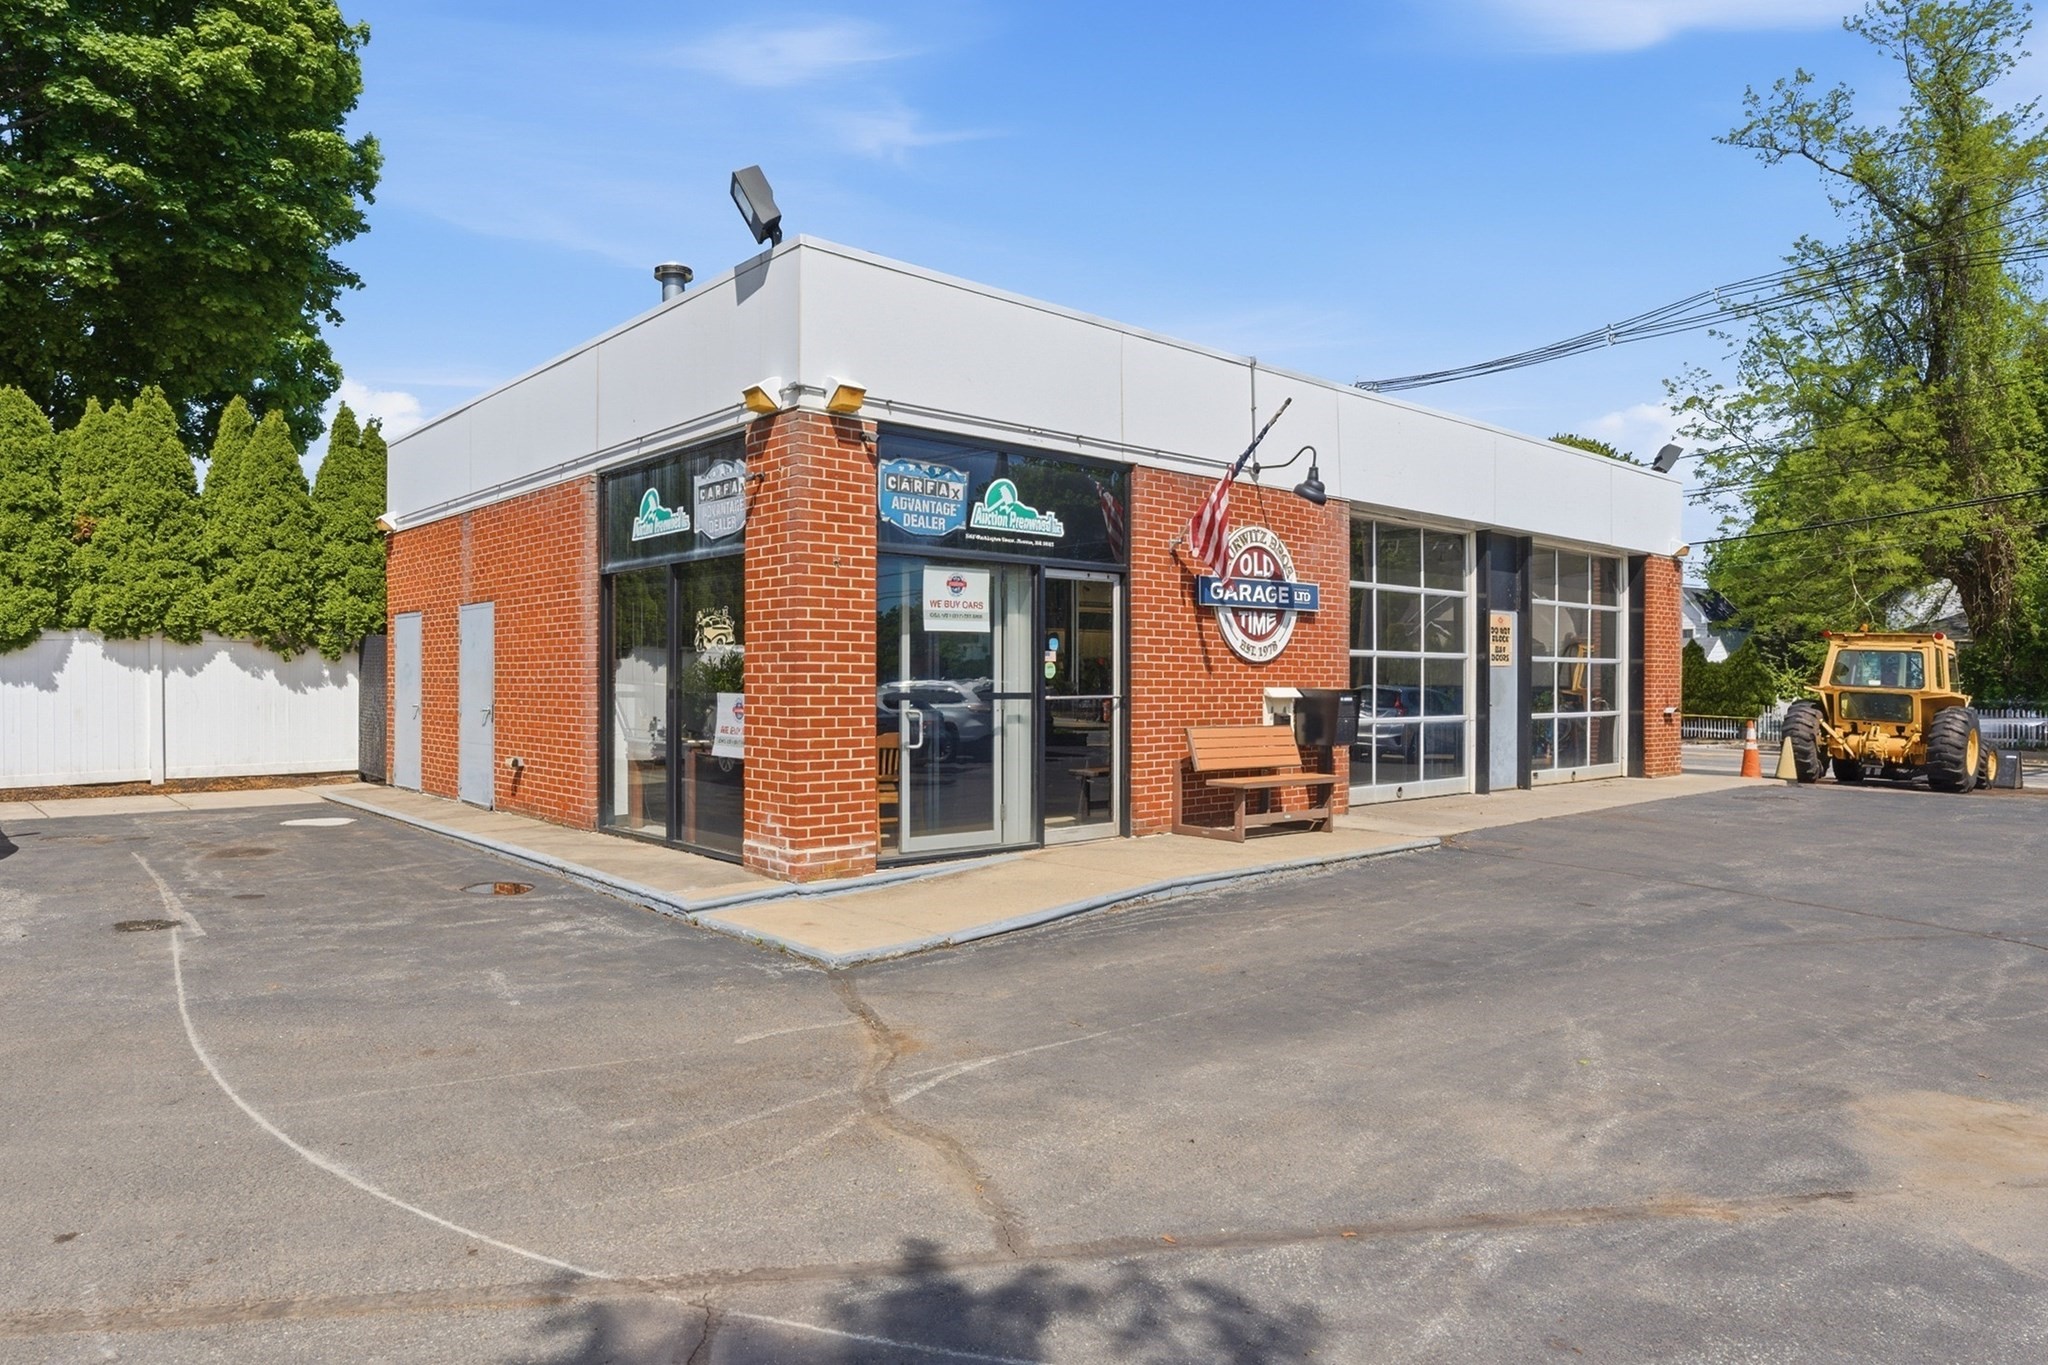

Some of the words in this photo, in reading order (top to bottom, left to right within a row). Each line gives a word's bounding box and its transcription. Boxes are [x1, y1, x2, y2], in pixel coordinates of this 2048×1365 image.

[887, 476, 960, 500] CARFAX
[892, 496, 957, 517] ADVANTAGE
[903, 513, 946, 531] DEALER
[1228, 529, 1267, 562] URWITZ
[1240, 552, 1274, 578] OLD
[1210, 582, 1290, 604] GARAGE
[1294, 591, 1311, 602] LTD
[929, 600, 943, 608] WE
[944, 600, 961, 609] BUY
[962, 601, 984, 610] CARS
[1238, 611, 1277, 636] TIME
